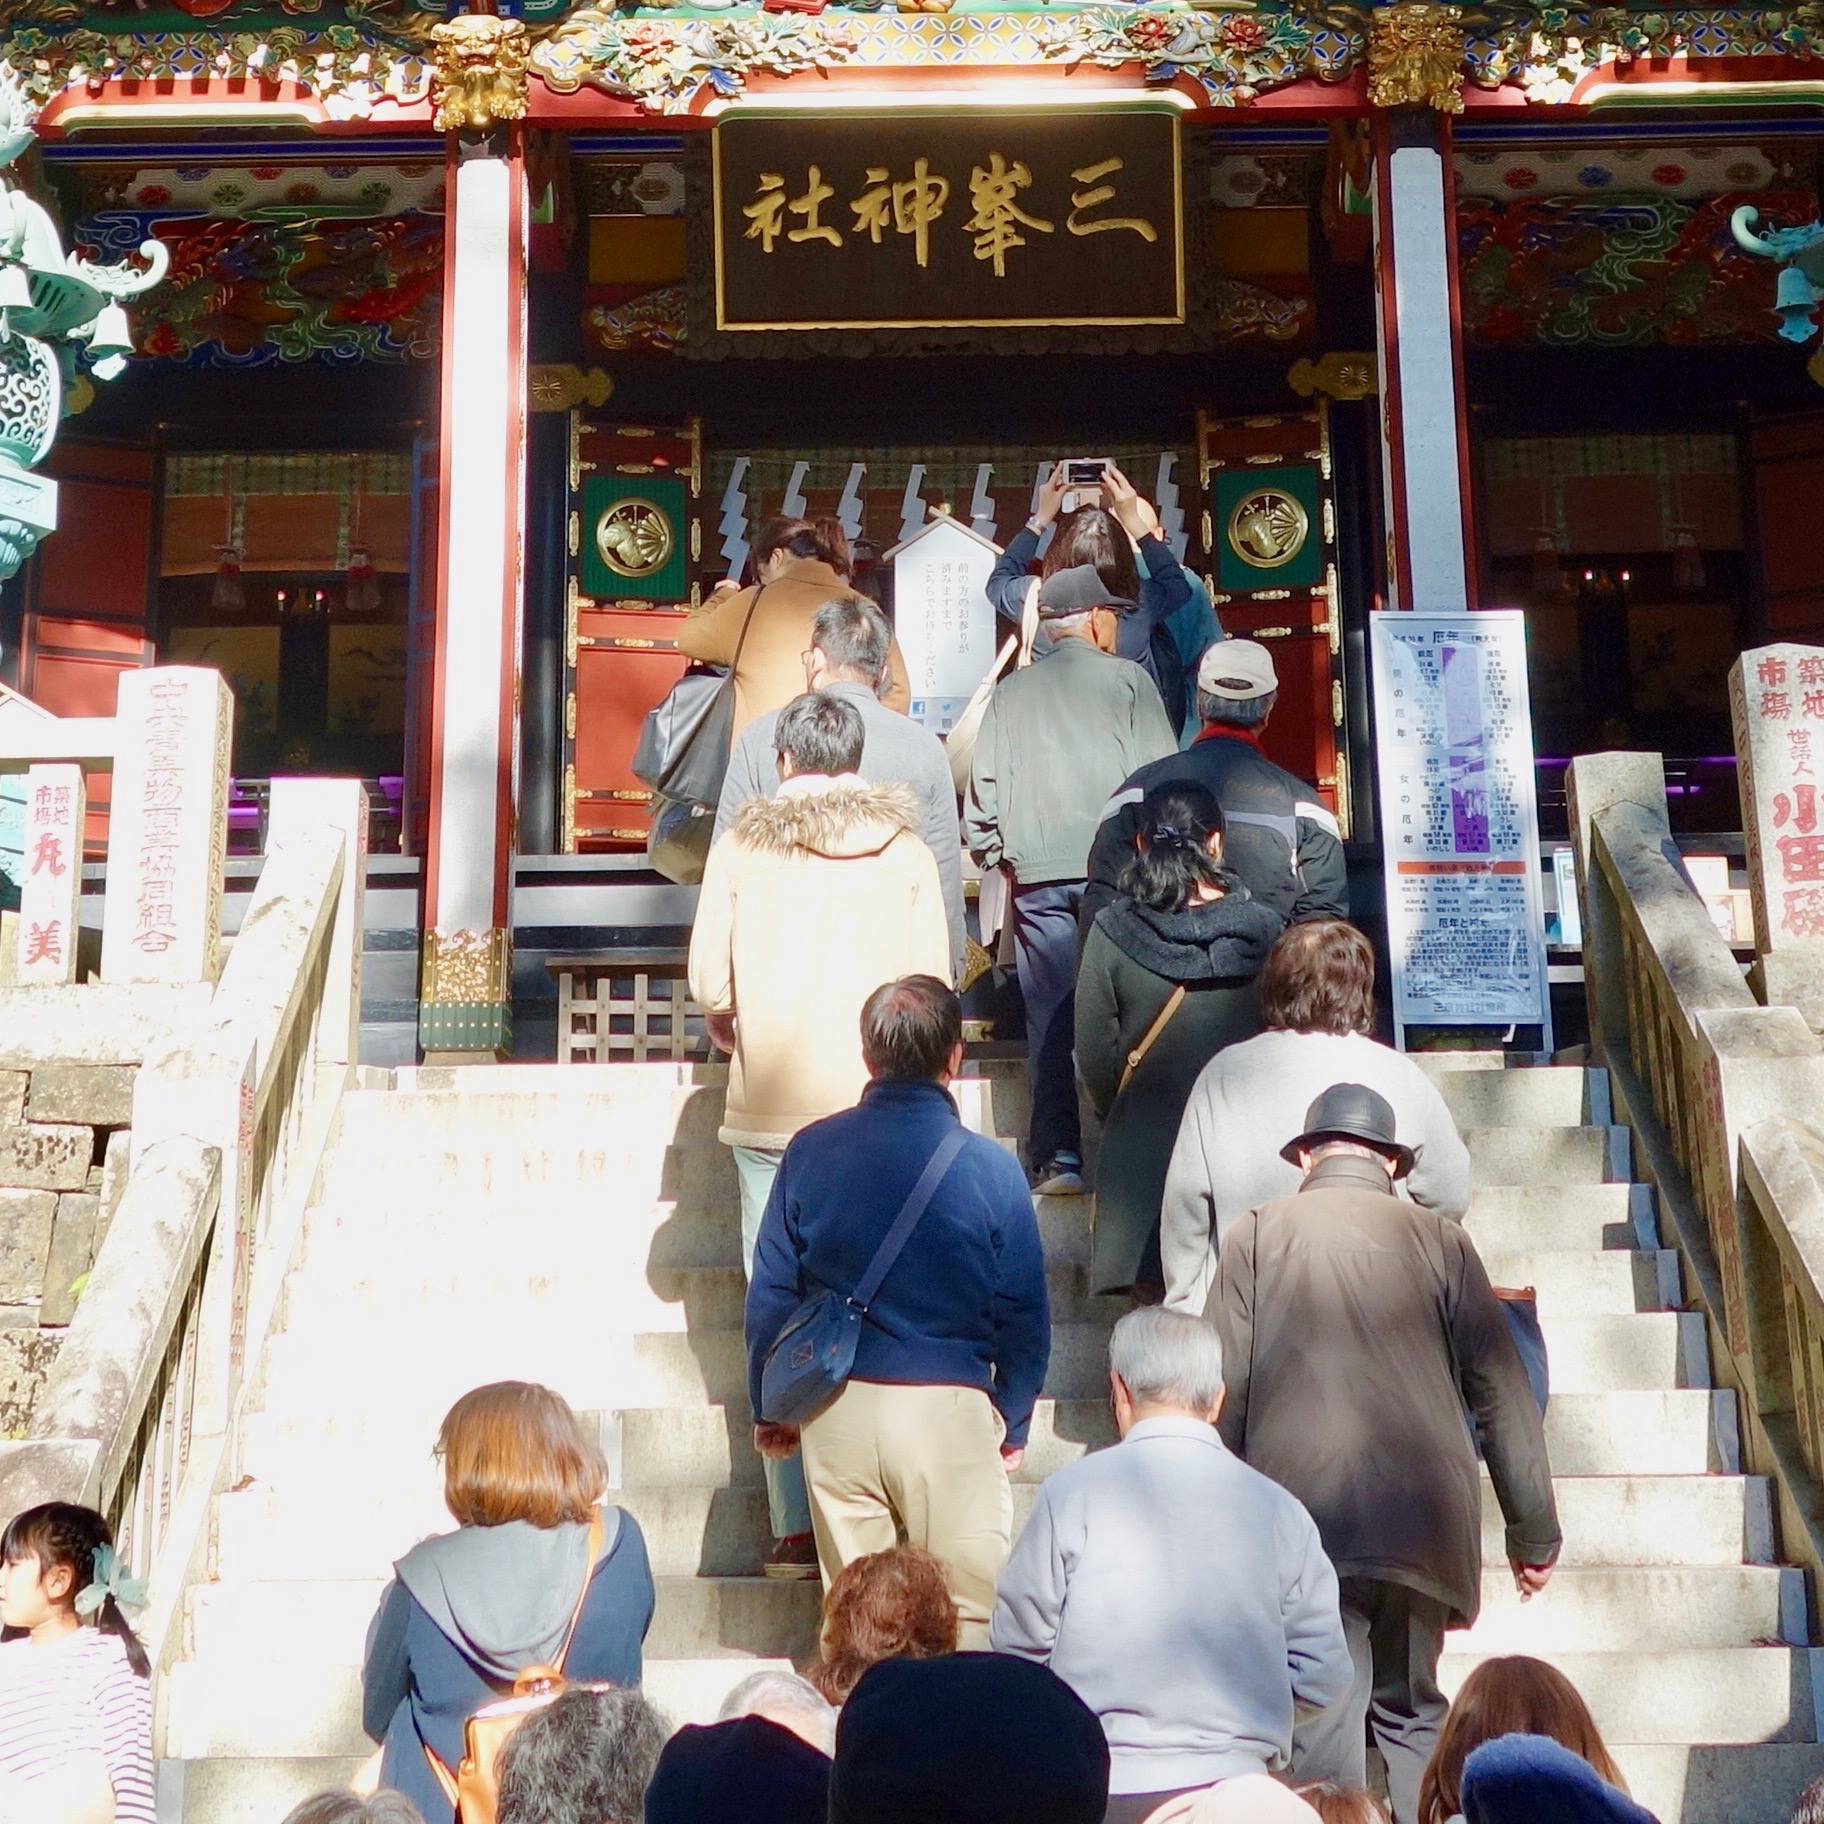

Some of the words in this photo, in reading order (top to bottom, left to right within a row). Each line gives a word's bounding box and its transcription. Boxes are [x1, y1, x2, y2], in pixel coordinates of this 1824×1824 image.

[741, 150, 1159, 277] 三峯神社
[924, 564, 937, 688] こちらでお待ちください
[941, 562, 953, 631] 済みますまで
[958, 562, 970, 654] 前の方のお参りが
[1433, 630, 1460, 644] 厄年
[1786, 728, 1814, 776] 世話人
[1399, 774, 1414, 844] 女の厄年
